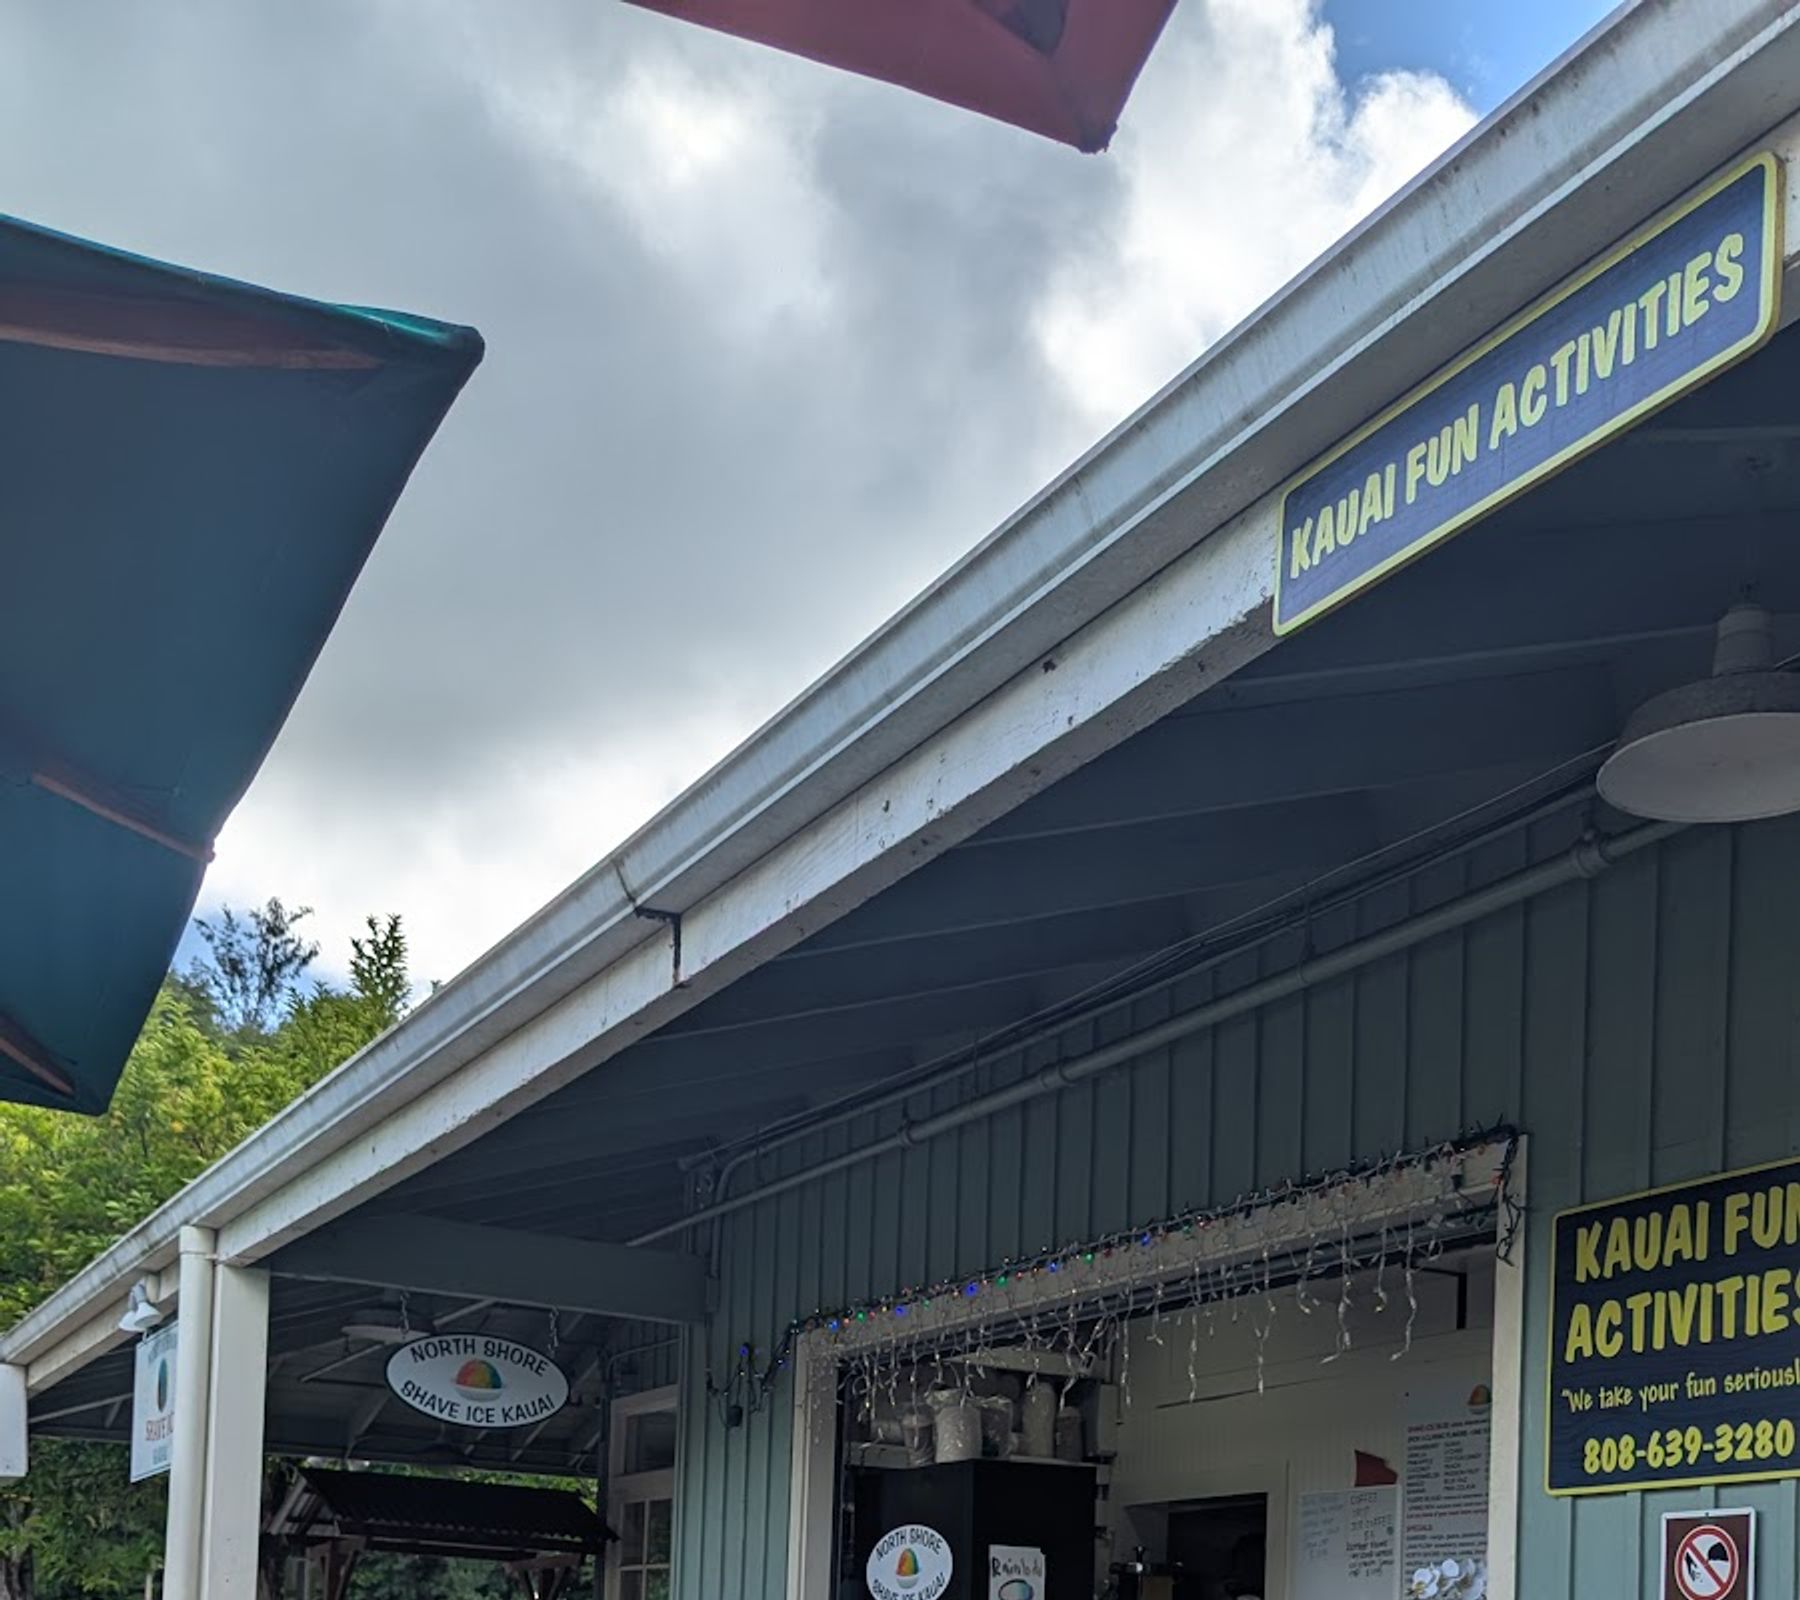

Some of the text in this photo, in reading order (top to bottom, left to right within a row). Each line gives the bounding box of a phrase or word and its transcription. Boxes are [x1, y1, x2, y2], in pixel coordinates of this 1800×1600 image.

[1289, 233, 1744, 579] KAUAI FUN ACTIVITIES
[1575, 1201, 1709, 1283] KAUAI
[1564, 1268, 1800, 1363] ACTIVITIE
[410, 1338, 549, 1377] NORTH SHORE
[401, 1380, 556, 1424] SHAVE ICE KAUAI
[1598, 1385, 1633, 1410] take
[1638, 1381, 1679, 1413] your
[1686, 1371, 1716, 1399] fun
[1583, 1418, 1795, 1475] 808-639-3280
[876, 1527, 943, 1561] NORTH SHORE
